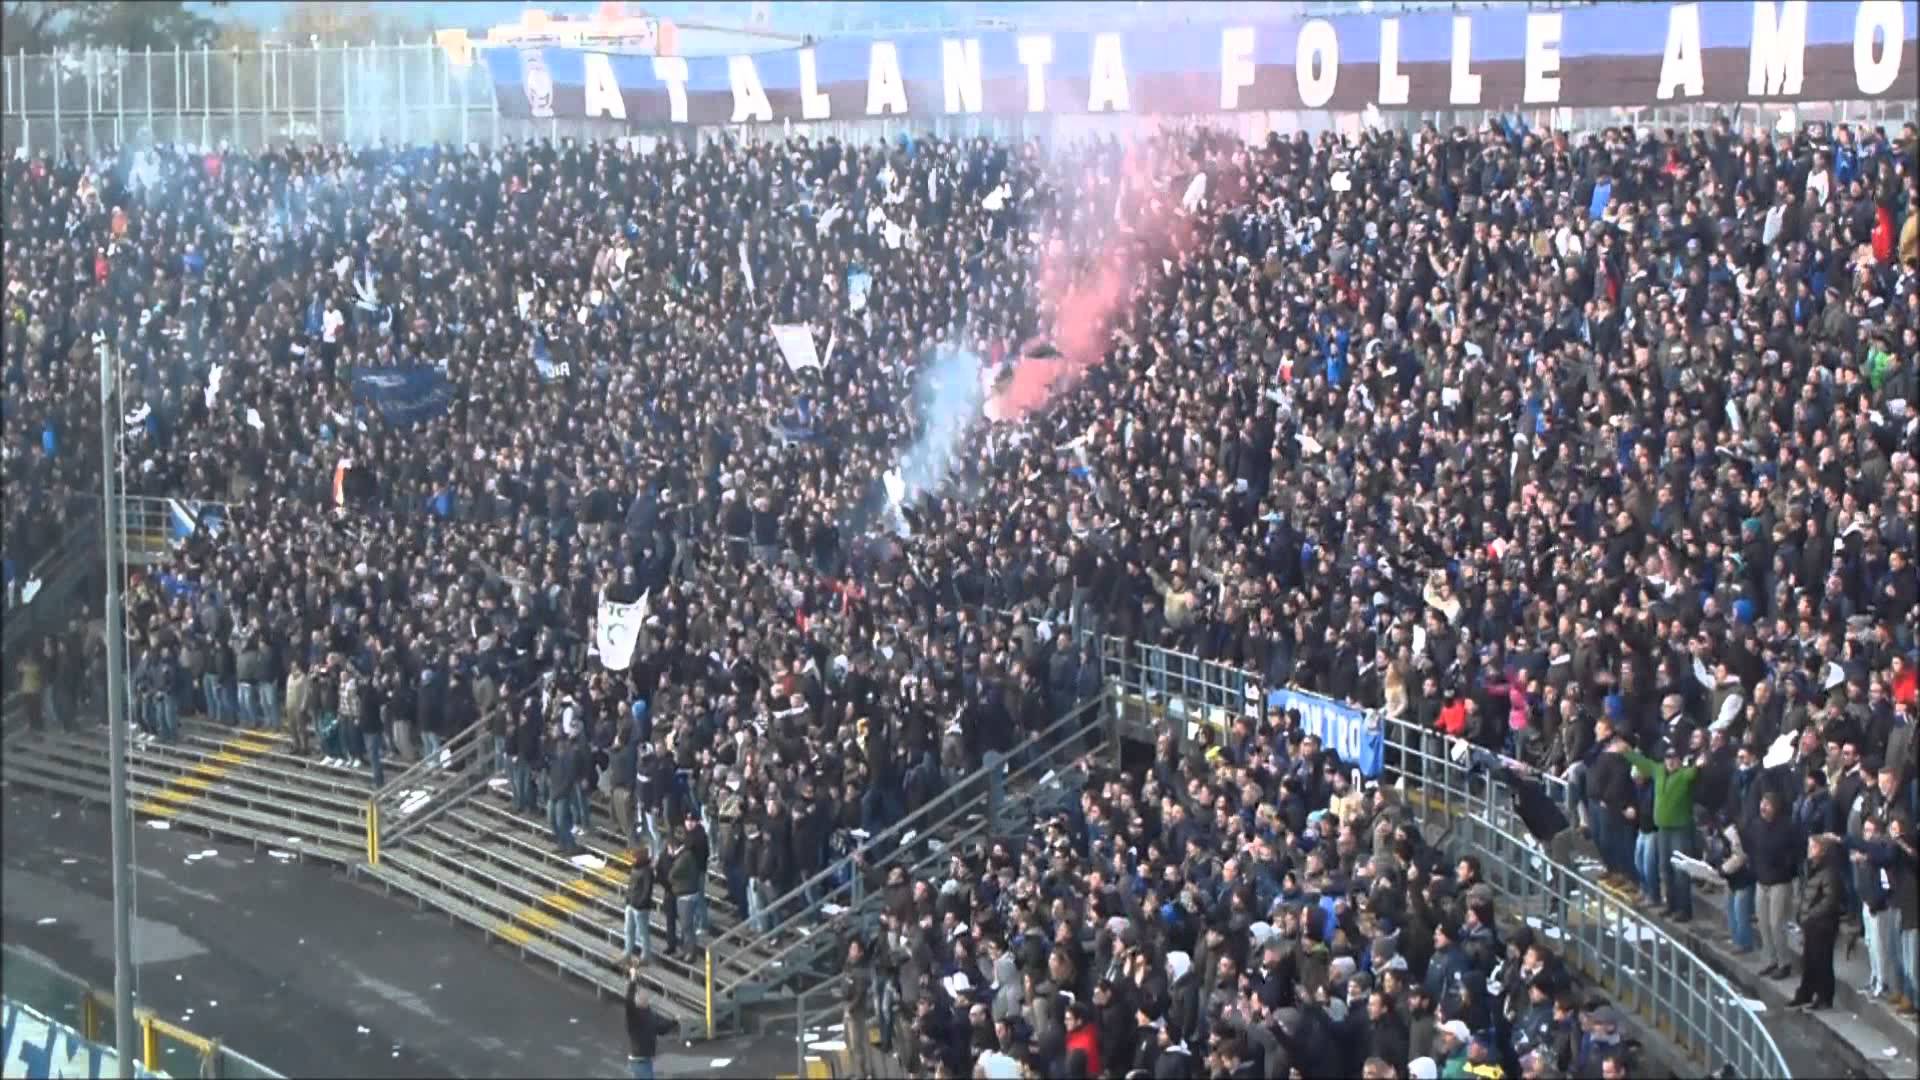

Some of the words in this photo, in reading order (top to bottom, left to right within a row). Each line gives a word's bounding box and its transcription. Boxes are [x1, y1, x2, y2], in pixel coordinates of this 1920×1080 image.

[584, 32, 1131, 122] ATALANTA
[1220, 13, 1562, 109] FOLLE
[1656, 1, 1905, 99] AMO
